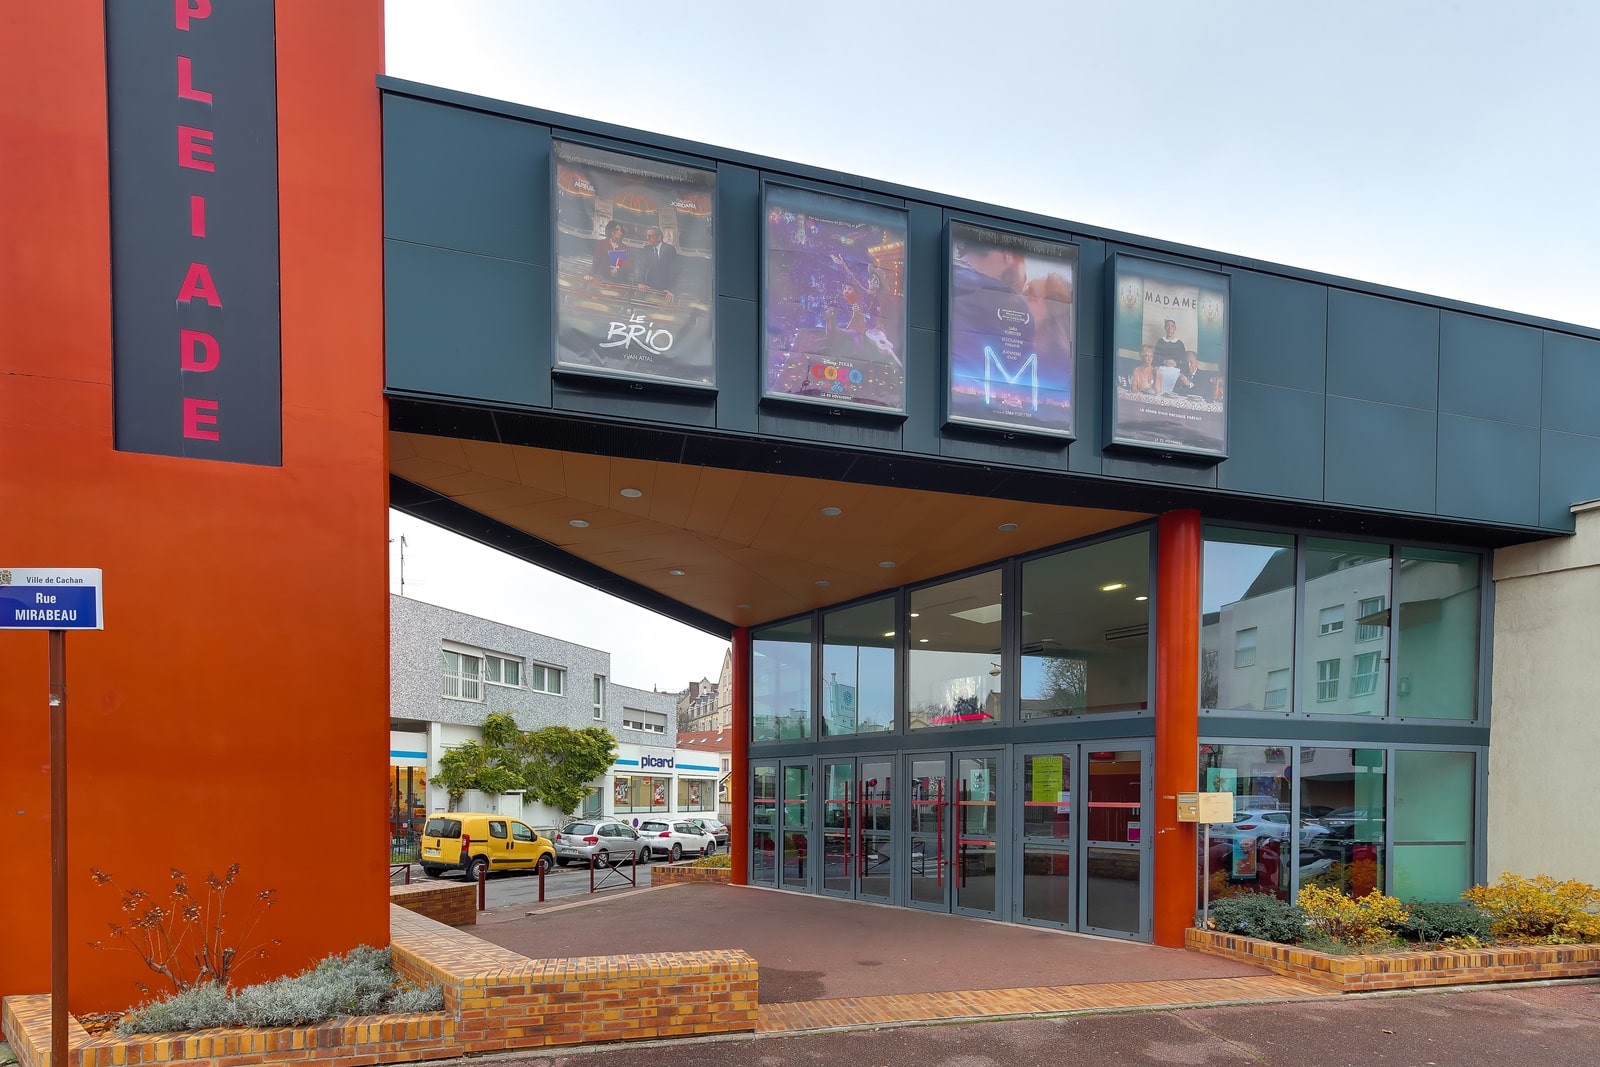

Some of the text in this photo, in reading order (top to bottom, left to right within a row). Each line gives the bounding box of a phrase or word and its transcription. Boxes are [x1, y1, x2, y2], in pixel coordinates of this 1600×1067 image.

[1145, 291, 1197, 310] MADAME
[629, 313, 646, 324] LE
[811, 363, 863, 384] COCO
[26, 576, 84, 584] Ville de Cachan
[35, 592, 57, 604] Rue
[15, 609, 77, 621] MIRABEAU
[641, 755, 674, 769] picard
